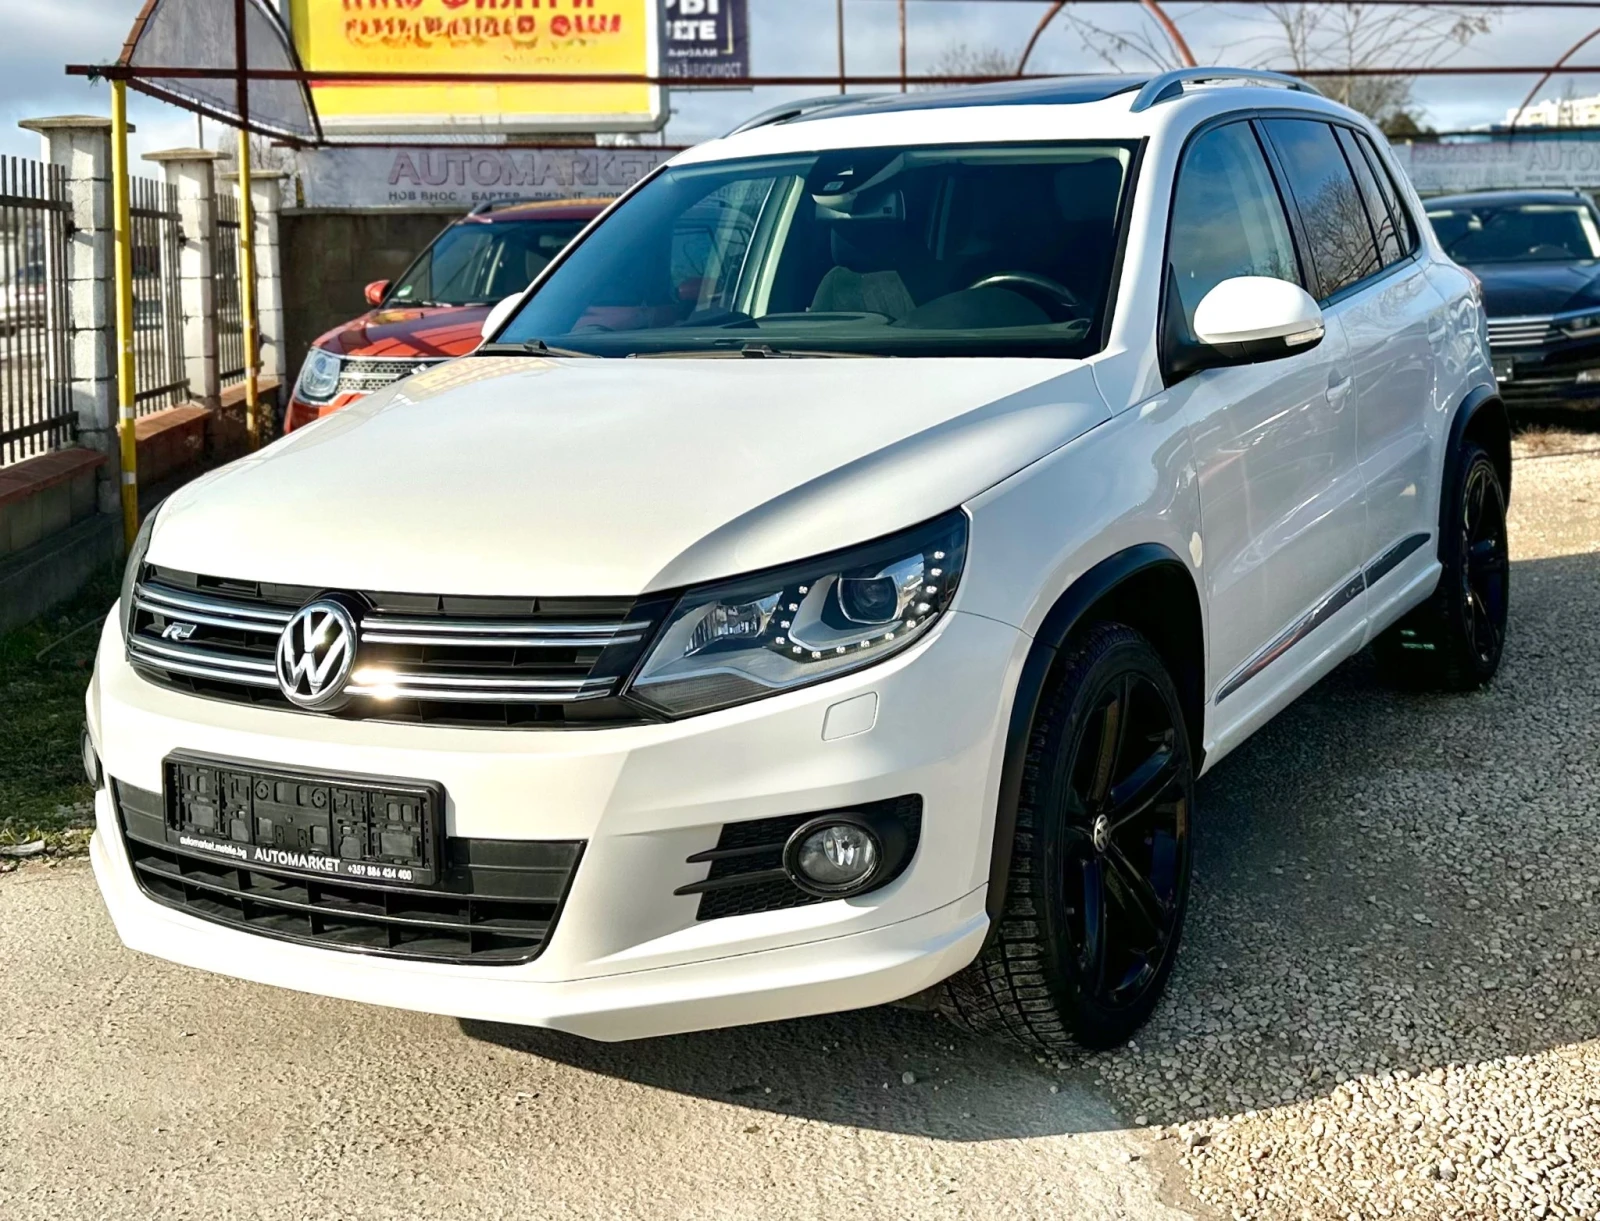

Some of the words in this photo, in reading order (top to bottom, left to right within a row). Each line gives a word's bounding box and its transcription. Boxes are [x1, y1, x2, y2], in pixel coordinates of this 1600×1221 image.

[388, 151, 658, 187] AUTOMARKET
[388, 191, 416, 200] НОВ
[420, 191, 457, 200] ВНОС
[279, 600, 355, 699] VW
[179, 836, 248, 860] automarket.mobile.bg
[254, 847, 340, 872] AUTOMARKET
[347, 864, 366, 876] +359
[367, 866, 381, 877] 886
[382, 867, 396, 879] 424
[397, 869, 412, 881] 400
